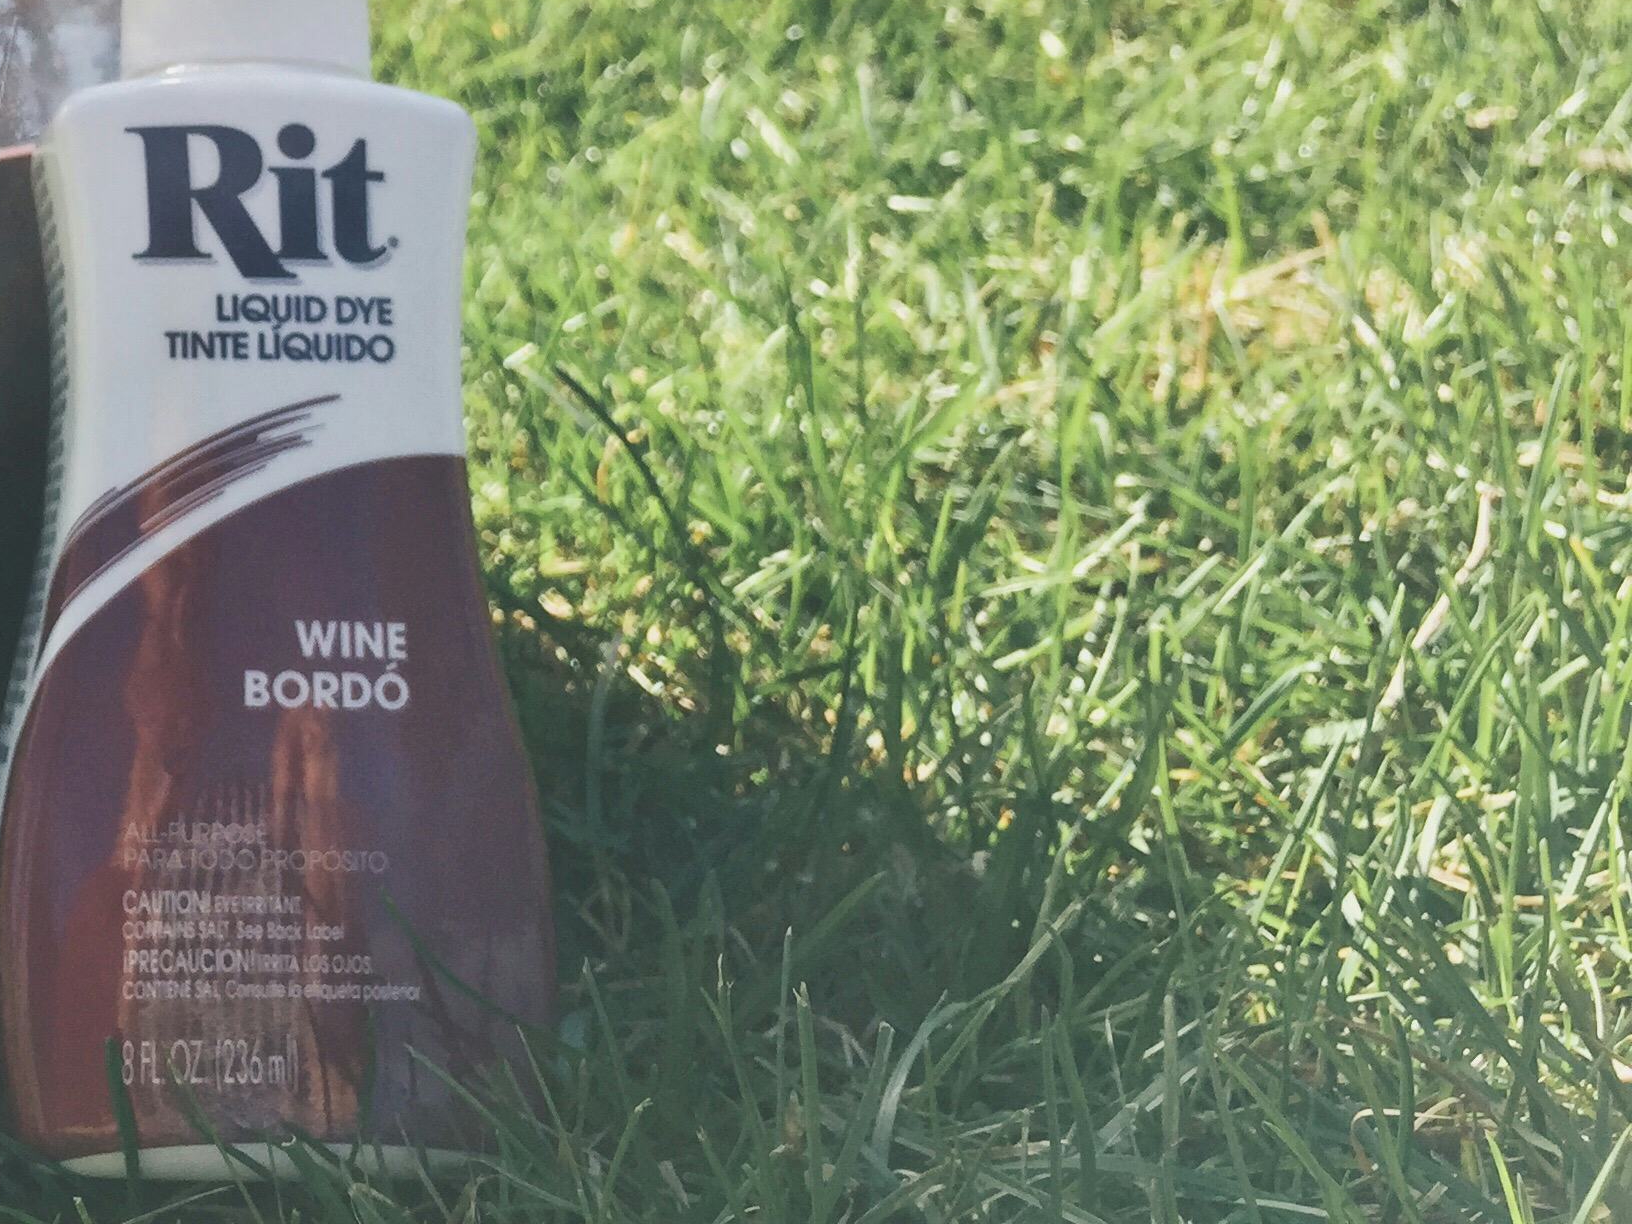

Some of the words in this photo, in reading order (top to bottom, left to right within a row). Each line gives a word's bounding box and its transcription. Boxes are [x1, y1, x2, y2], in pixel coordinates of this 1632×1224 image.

[125, 123, 386, 282] Rit
[216, 294, 327, 324] LIQUID
[335, 296, 393, 325] DYE
[165, 331, 248, 360] TINTE
[257, 323, 395, 363] LÍQUIDO
[294, 620, 408, 660] WINE
[243, 662, 410, 710] BORDÓ
[123, 849, 187, 871] PARA
[190, 849, 256, 871] TODO
[121, 1040, 135, 1086] 8
